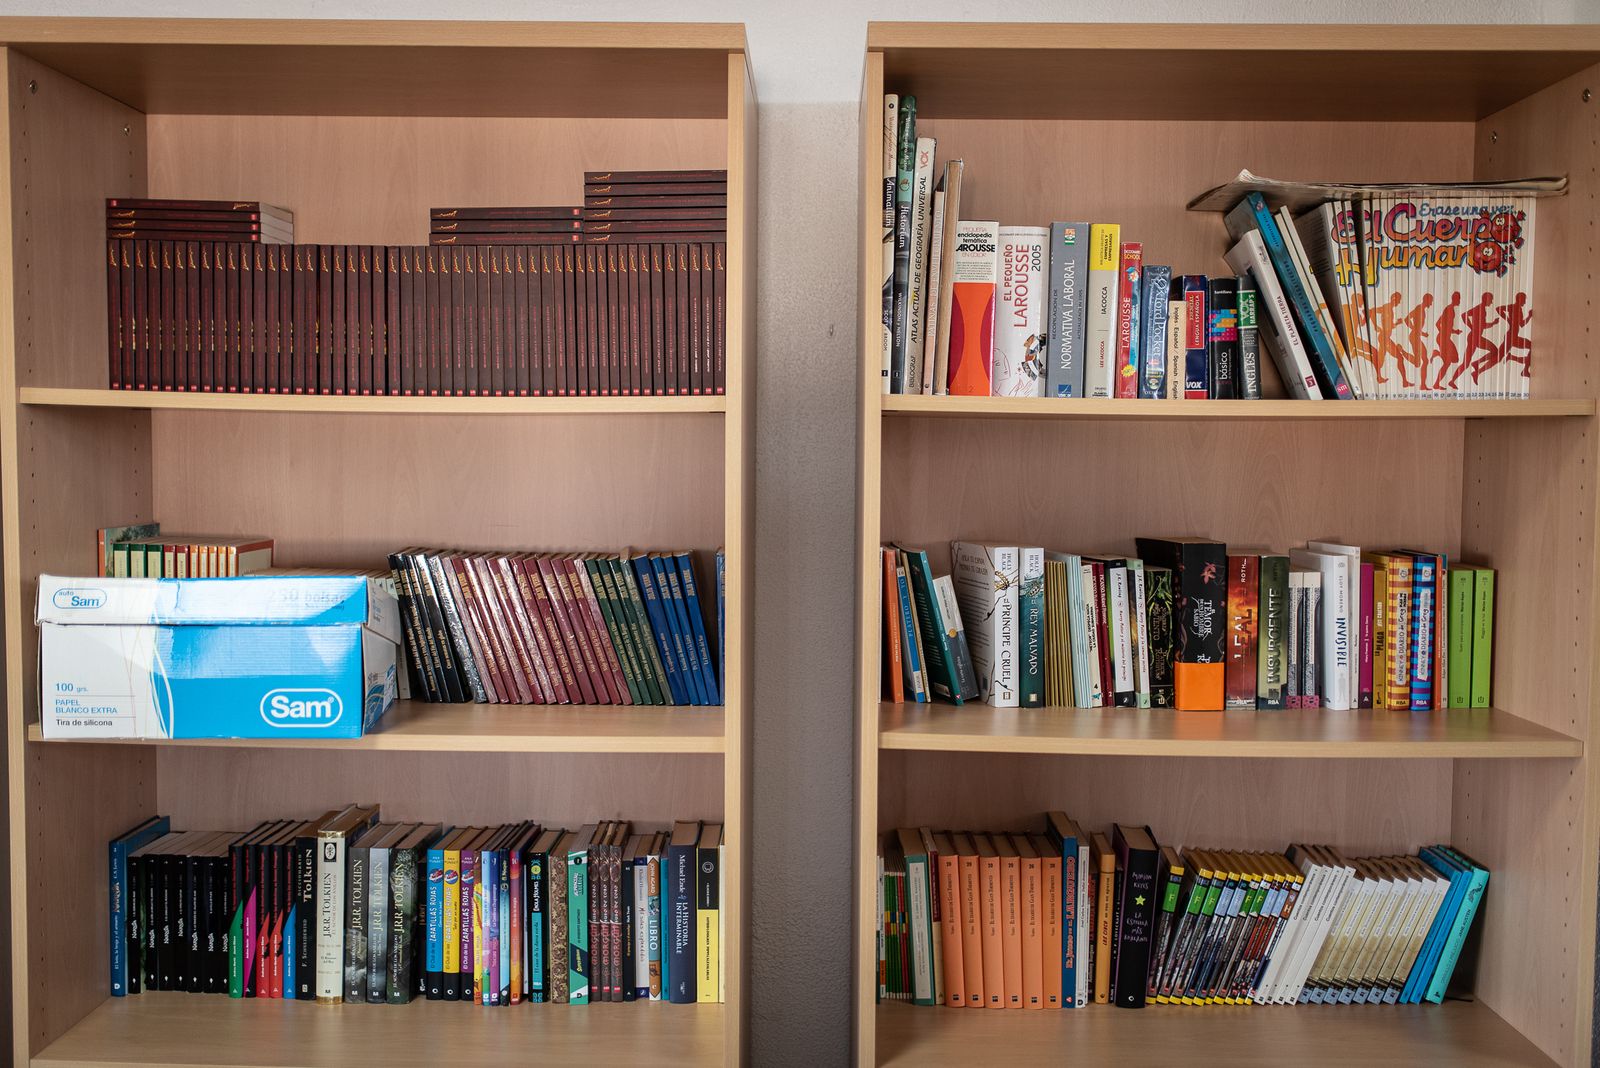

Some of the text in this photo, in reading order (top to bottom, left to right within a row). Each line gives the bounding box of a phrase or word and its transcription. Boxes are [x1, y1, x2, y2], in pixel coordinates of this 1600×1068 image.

[885, 178, 895, 227] Animalium
[1418, 203, 1458, 216] Erase
[899, 206, 909, 248] Historium
[910, 151, 929, 344] ATLAS ACTUAL DE GEOGRAFÍA UNIVERSAL VOX
[1031, 244, 1042, 272] 2005
[1004, 244, 1014, 302] EL PEQUEÑO
[1014, 244, 1029, 328] LAROUSSE
[1061, 260, 1074, 370] NORMATIVA LABORAL
[1240, 299, 1248, 320] VOX
[1276, 296, 1289, 318] TIERRA
[1122, 297, 1130, 348] LAROUSSE
[1286, 318, 1298, 340] PLANETA
[1219, 352, 1228, 380] básico
[1186, 381, 1202, 389] VOX
[1337, 384, 1348, 394] sm
[640, 572, 656, 601] JULIO VERNE
[656, 572, 670, 600] JULIO VERNE
[667, 571, 682, 600] JULIO VERNE
[681, 568, 695, 597] JULIO VERNE
[71, 596, 99, 607] Sam
[1399, 609, 1407, 622] Greg
[1153, 617, 1161, 640] VIENTO
[1203, 600, 1212, 634] TEMOR
[1002, 604, 1012, 682] PRÍNCIPE CRUEL
[1029, 608, 1038, 675] REY MALVADO
[1234, 608, 1252, 659] LEAL
[1268, 588, 1280, 683] INSURGENTE
[1336, 617, 1347, 667] INVISIBLE
[1376, 632, 1384, 651] PLAGA
[56, 683, 74, 692] 100
[352, 859, 362, 906] TOLKIEN
[374, 862, 382, 908] TOLKIEN
[393, 863, 404, 909] TOLKIEN
[322, 873, 331, 937] J.R.R. TOLKIEN
[352, 907, 362, 929] J.R.R.
[374, 909, 383, 930] J.R.R.
[682, 902, 687, 911] LA
[1066, 856, 1075, 968] EL JUEGO LARGUERO
[393, 910, 404, 932] J.R.R.
[650, 919, 658, 950] LIBRO
[1457, 909, 1471, 939] JANE AUSTEN
